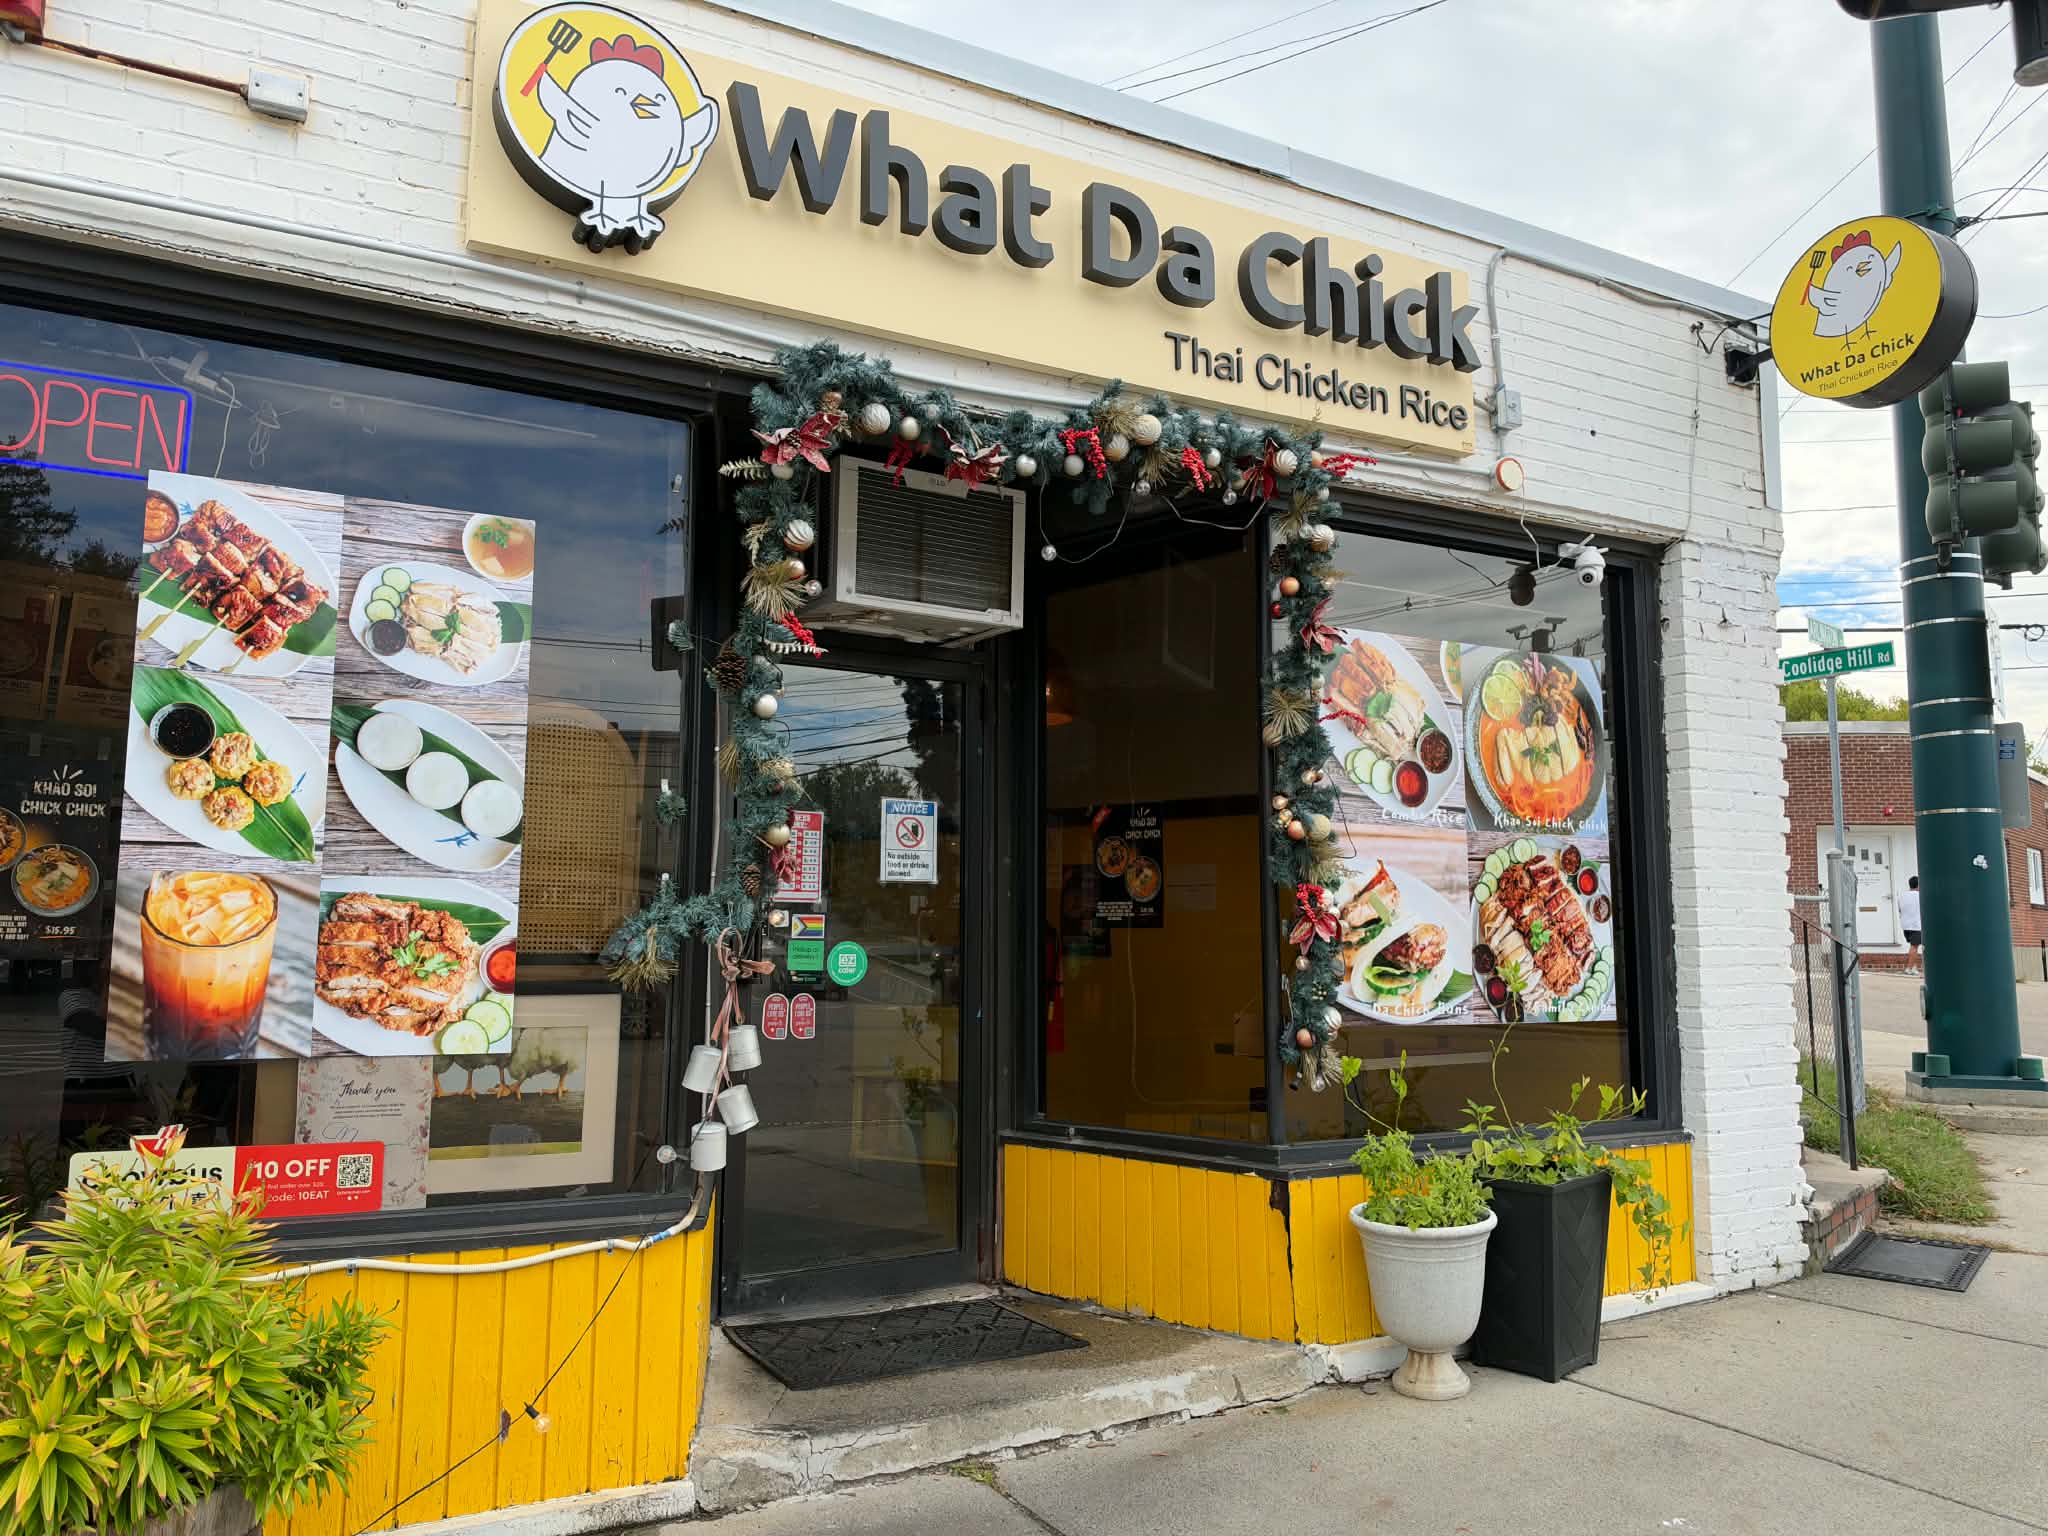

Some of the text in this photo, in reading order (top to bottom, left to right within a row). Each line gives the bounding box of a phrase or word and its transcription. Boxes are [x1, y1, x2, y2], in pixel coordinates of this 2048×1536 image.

[726, 80, 1481, 374] What Da Chick
[1800, 333, 1915, 384] What Da Chick
[1165, 331, 1469, 431] Thai Chicken Rice
[0, 374, 186, 473] OPEN
[1782, 648, 1890, 677] Coolidge Hill Rd
[33, 781, 71, 797] KHAO
[20, 800, 107, 818] CHICK CHICK
[891, 800, 929, 814] NOTICE
[339, 1080, 372, 1098] Thank
[375, 1087, 397, 1101] you
[285, 1158, 332, 1178] OFF
[299, 1190, 330, 1201] 10EAT
